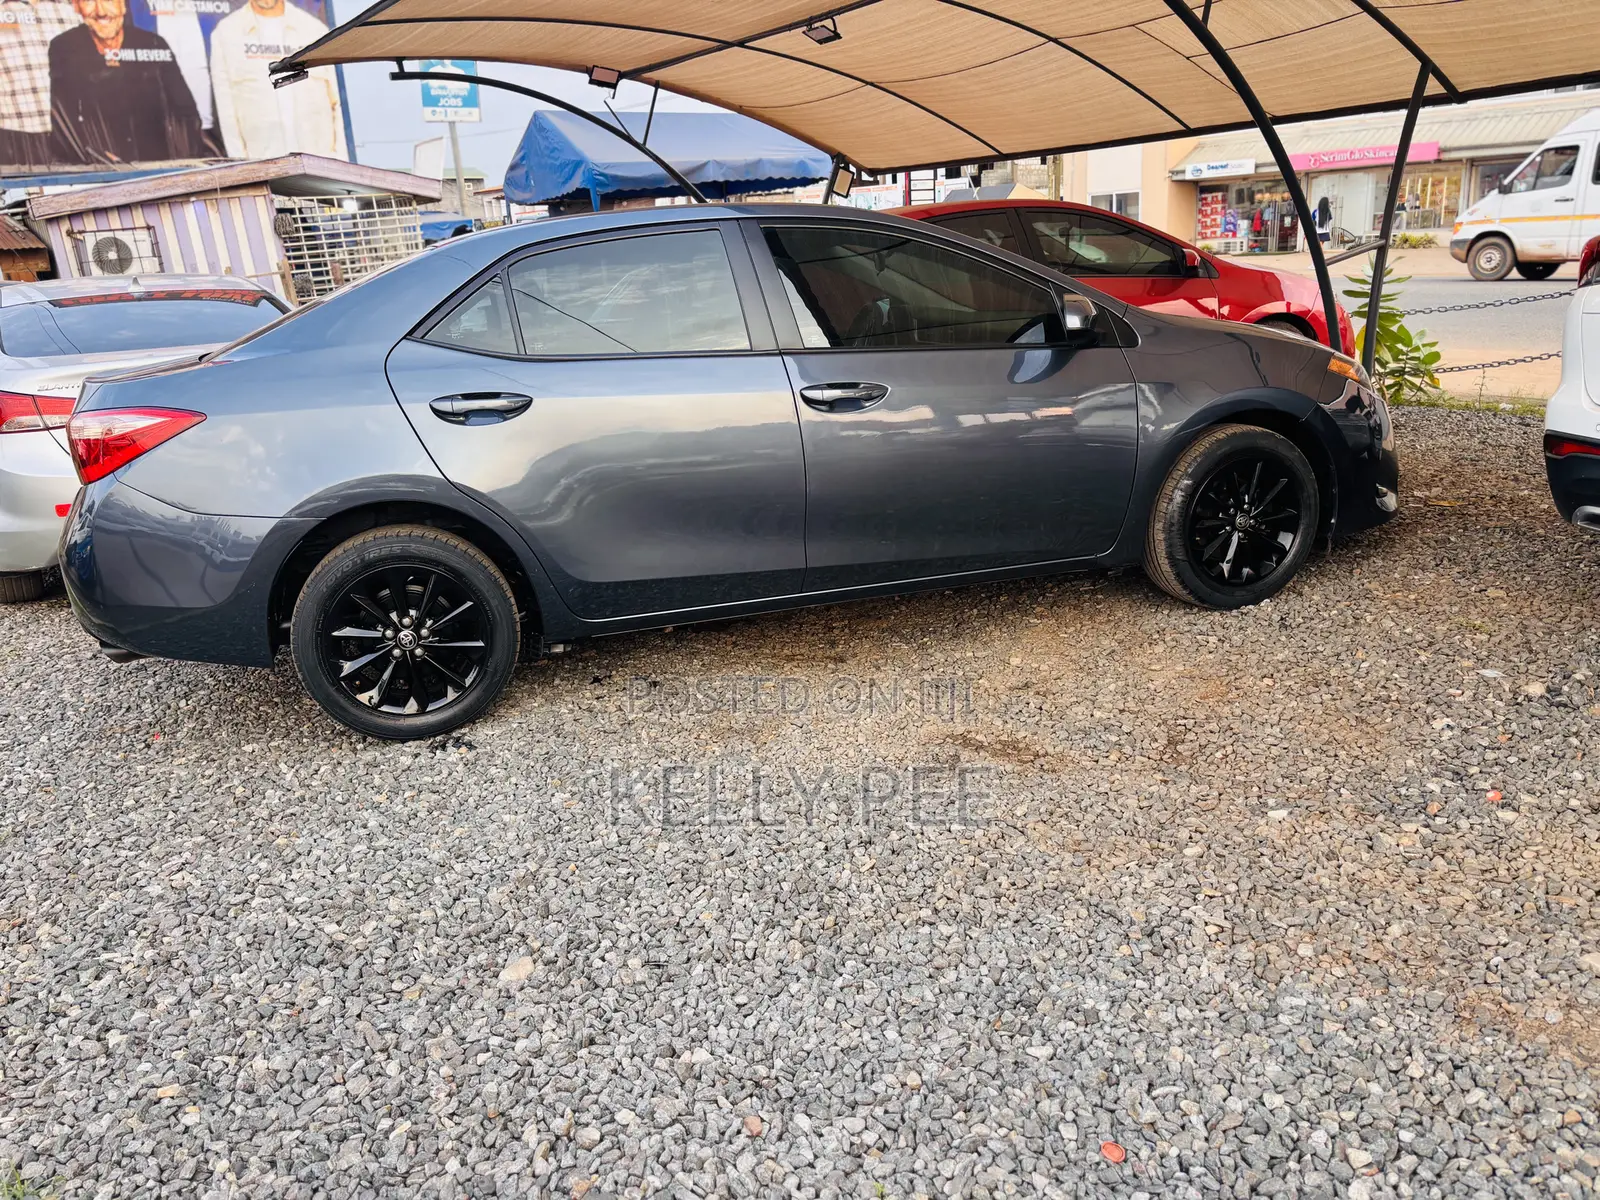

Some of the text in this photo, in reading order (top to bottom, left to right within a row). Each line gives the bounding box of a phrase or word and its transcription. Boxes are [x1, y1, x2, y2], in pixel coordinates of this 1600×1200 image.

[244, 43, 282, 54] JOSHUA
[104, 48, 173, 62] JOHN BEVERE
[438, 97, 463, 107] JOBS
